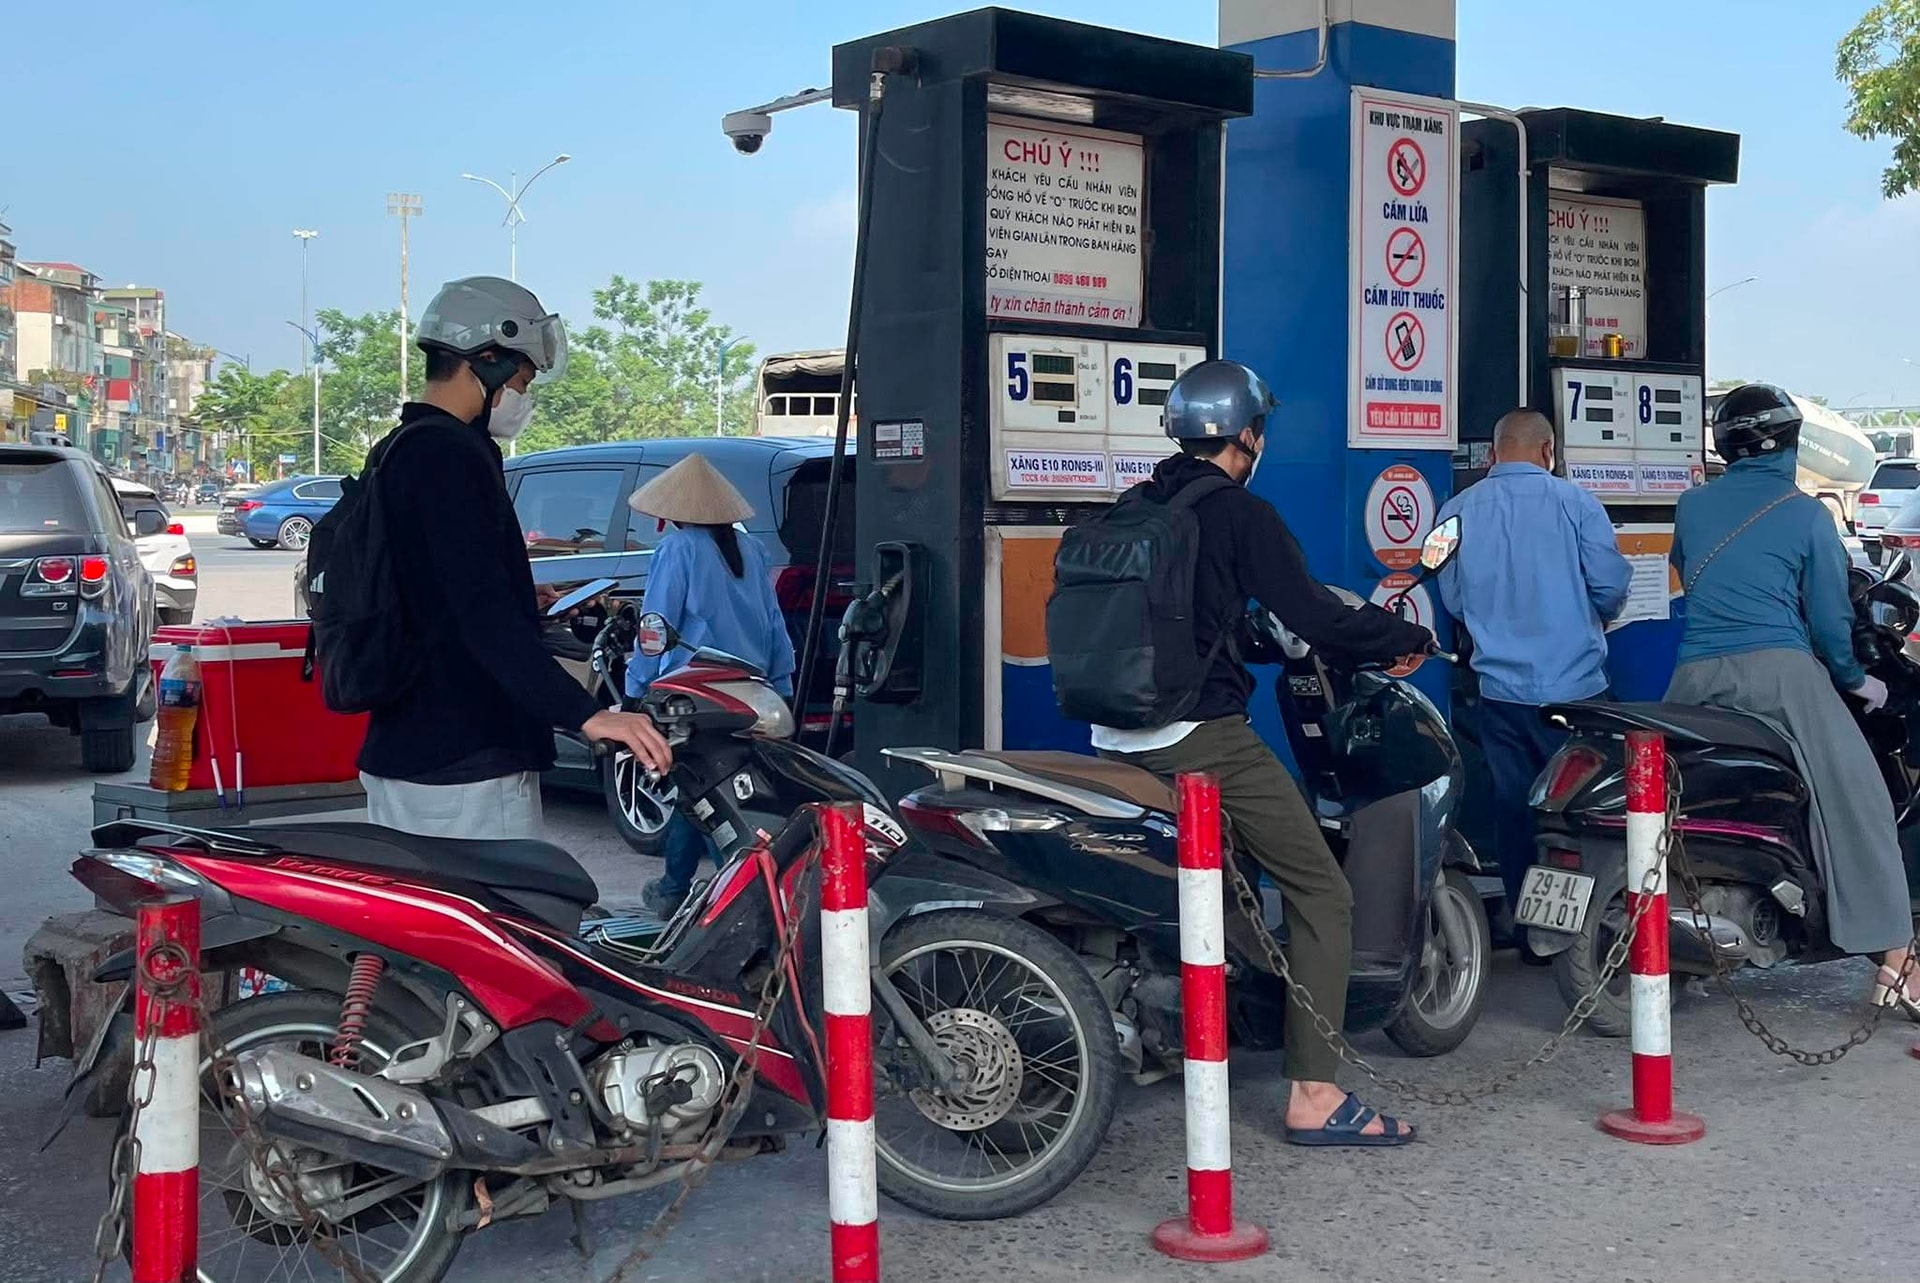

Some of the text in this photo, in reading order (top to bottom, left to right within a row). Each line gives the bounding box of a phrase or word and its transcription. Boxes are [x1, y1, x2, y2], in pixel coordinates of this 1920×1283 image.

[1369, 111, 1384, 126] KHU
[1402, 115, 1422, 133] TRẠM
[1424, 117, 1443, 135] XĂNG
[1004, 138, 1100, 172] CHÚ Ý !!!
[991, 168, 1137, 199] KHÁCH YÊU CẦU NHÂN VIÊN
[1017, 188, 1032, 204] HỒ
[1034, 191, 1047, 205] VỀ
[1069, 196, 1099, 212] TRƯỚC
[1101, 200, 1115, 214] KHI
[1117, 203, 1137, 217] BƠM
[1383, 197, 1428, 223] CẤM LỬA
[989, 206, 1011, 220] QUÝ
[1014, 209, 1049, 225] KHÁCH
[1052, 212, 1075, 228] NÀO
[1078, 216, 1100, 231] PHÁT
[1125, 224, 1137, 236] RA
[1549, 207, 1609, 233] CHÚ Ý !!!
[986, 247, 1008, 259] GAY
[988, 227, 1011, 241] VIÊN
[1012, 230, 1039, 243] GIAN
[1059, 235, 1090, 249] TRONG
[1111, 240, 1137, 254] HÀNG
[1599, 239, 1619, 251] NHÂN
[999, 266, 1022, 282] ĐIỆN
[1610, 257, 1622, 267] KHI
[990, 295, 1002, 312] ty
[1004, 296, 1020, 311] xin
[1024, 295, 1051, 314] chân
[1054, 298, 1085, 316] thành
[1088, 300, 1109, 318] cảm
[1112, 306, 1126, 320] ơn
[1364, 285, 1445, 310] CẤM HÚT THUỐC
[1007, 352, 1133, 405] 5 6
[1567, 381, 1652, 424] 7 8
[1010, 454, 1104, 473] XĂNG E10 RON95-III
[1115, 458, 1151, 474] XĂNG E10
[1571, 466, 1591, 479] XĂNG
[870, 818, 904, 843] 110
[1531, 872, 1578, 901] 29-AL
[1520, 897, 1580, 929] 071.01
[664, 977, 742, 1006] HONDA
